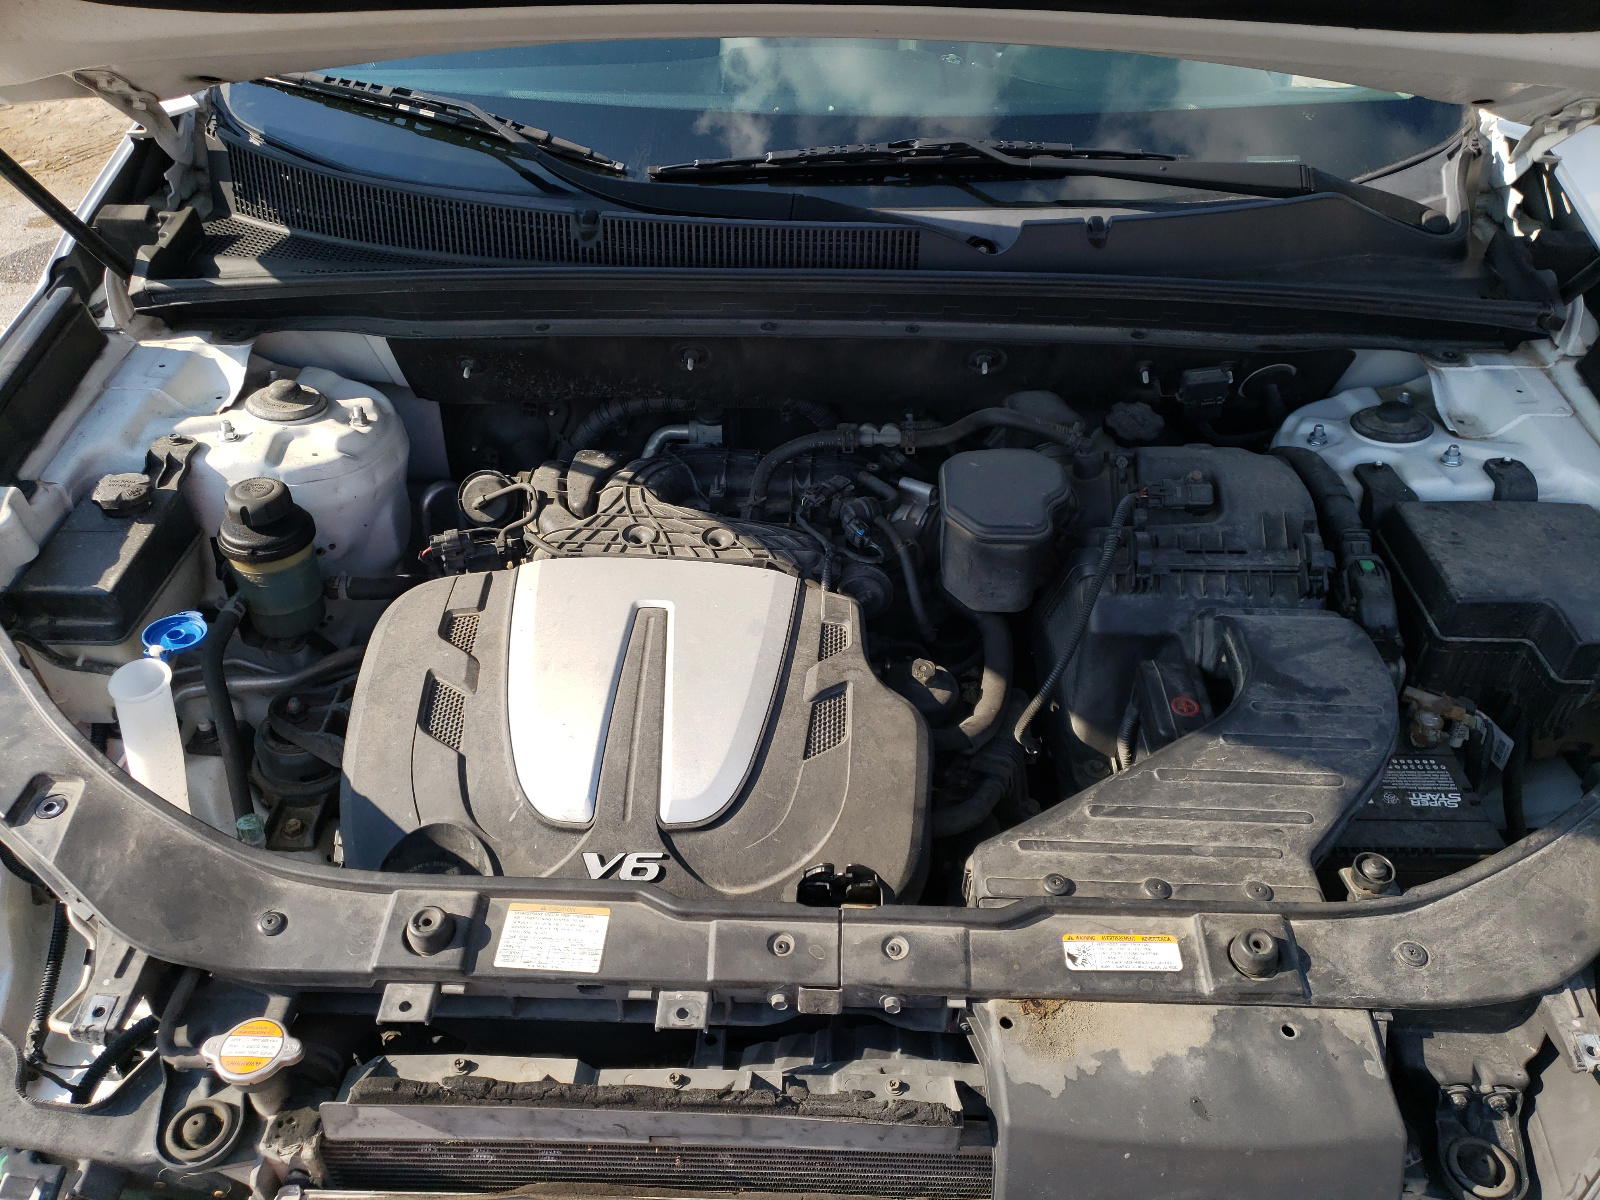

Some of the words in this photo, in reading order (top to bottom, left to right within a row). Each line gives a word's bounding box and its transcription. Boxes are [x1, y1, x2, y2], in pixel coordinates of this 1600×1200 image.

[1408, 792, 1462, 801] START
[1410, 799, 1459, 808] SUPER
[582, 852, 664, 881] V6
